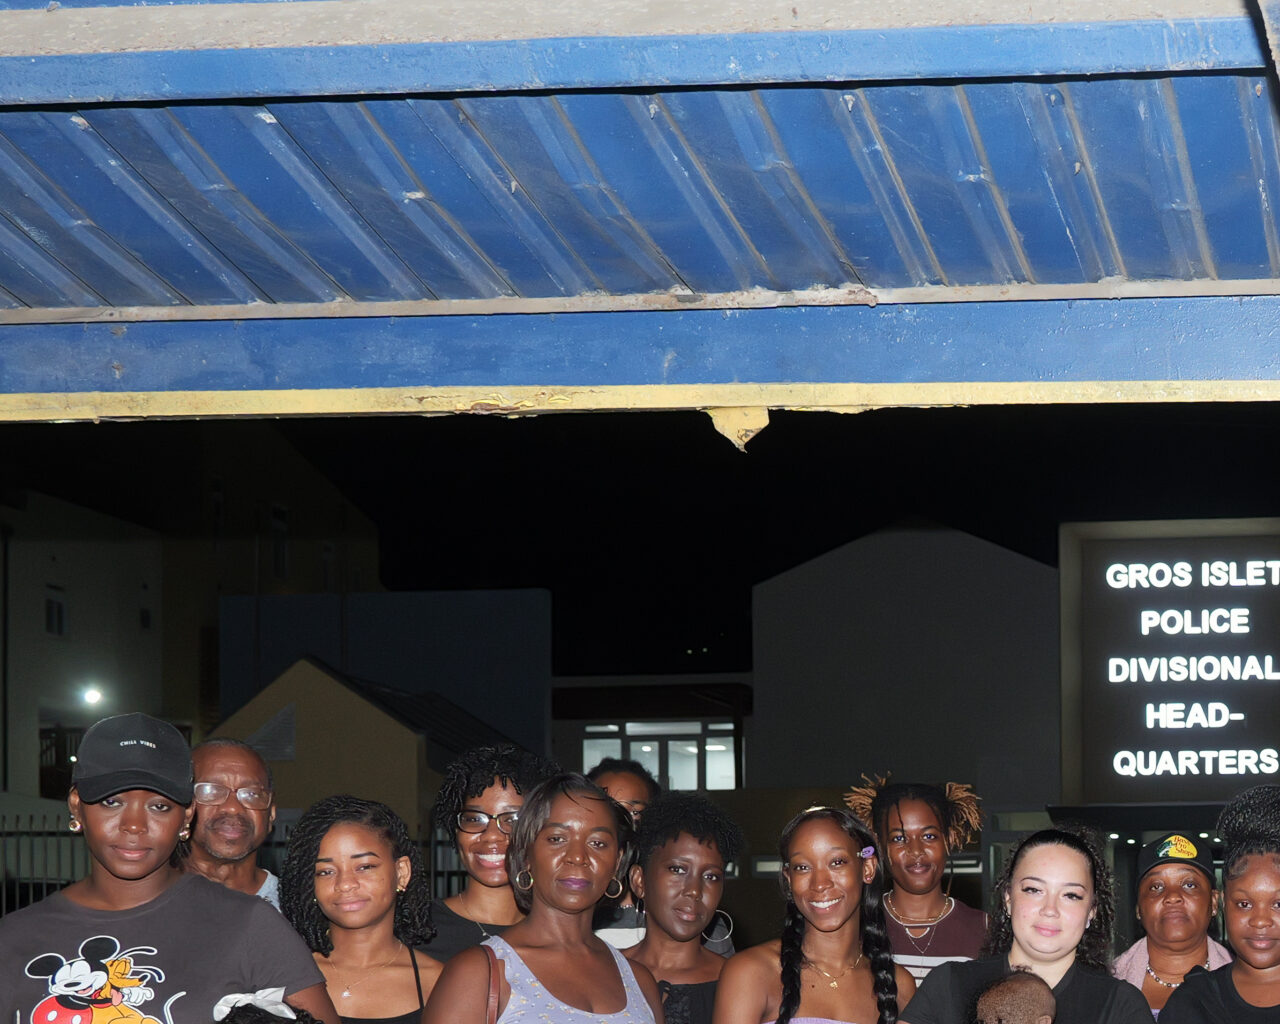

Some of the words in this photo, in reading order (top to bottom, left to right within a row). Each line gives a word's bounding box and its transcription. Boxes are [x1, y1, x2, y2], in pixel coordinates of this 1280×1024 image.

[1106, 562, 1192, 588] GROS
[1141, 608, 1250, 635] POLICE
[1146, 702, 1244, 729] HEAD-
[1113, 748, 1279, 777] QUARTERS
